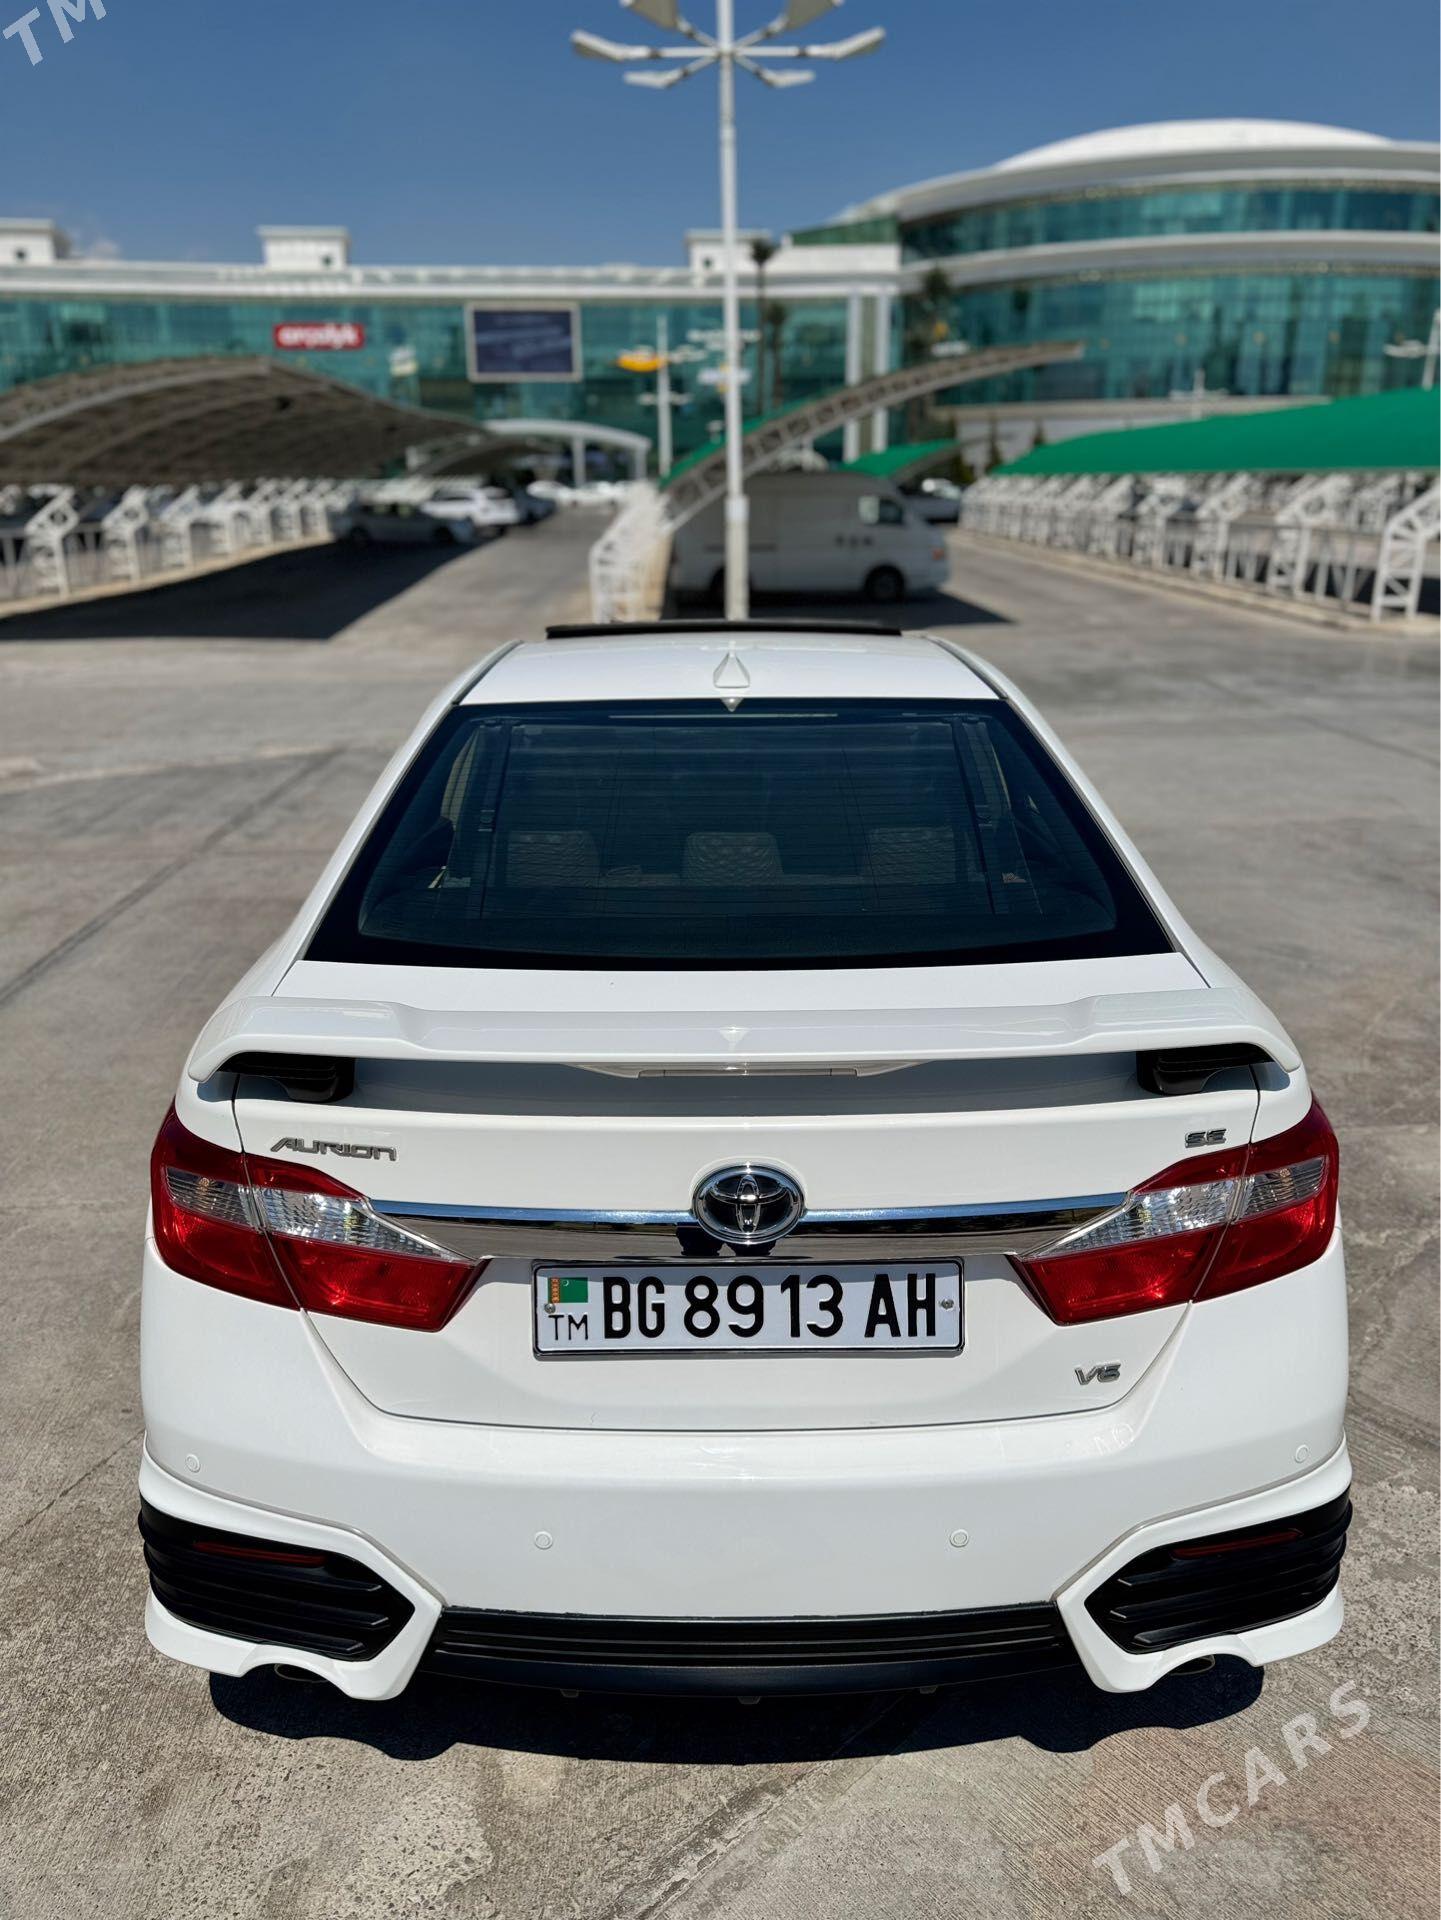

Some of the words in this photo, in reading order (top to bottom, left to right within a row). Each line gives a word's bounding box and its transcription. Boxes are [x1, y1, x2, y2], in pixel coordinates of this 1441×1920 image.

[270, 1137, 397, 1161] AURION
[1185, 1128, 1227, 1148] SE
[603, 1275, 664, 1339] BG
[683, 1274, 843, 1339] 8913
[864, 1273, 936, 1338] AH
[548, 1314, 588, 1341] TM
[1074, 1363, 1121, 1386] V6
